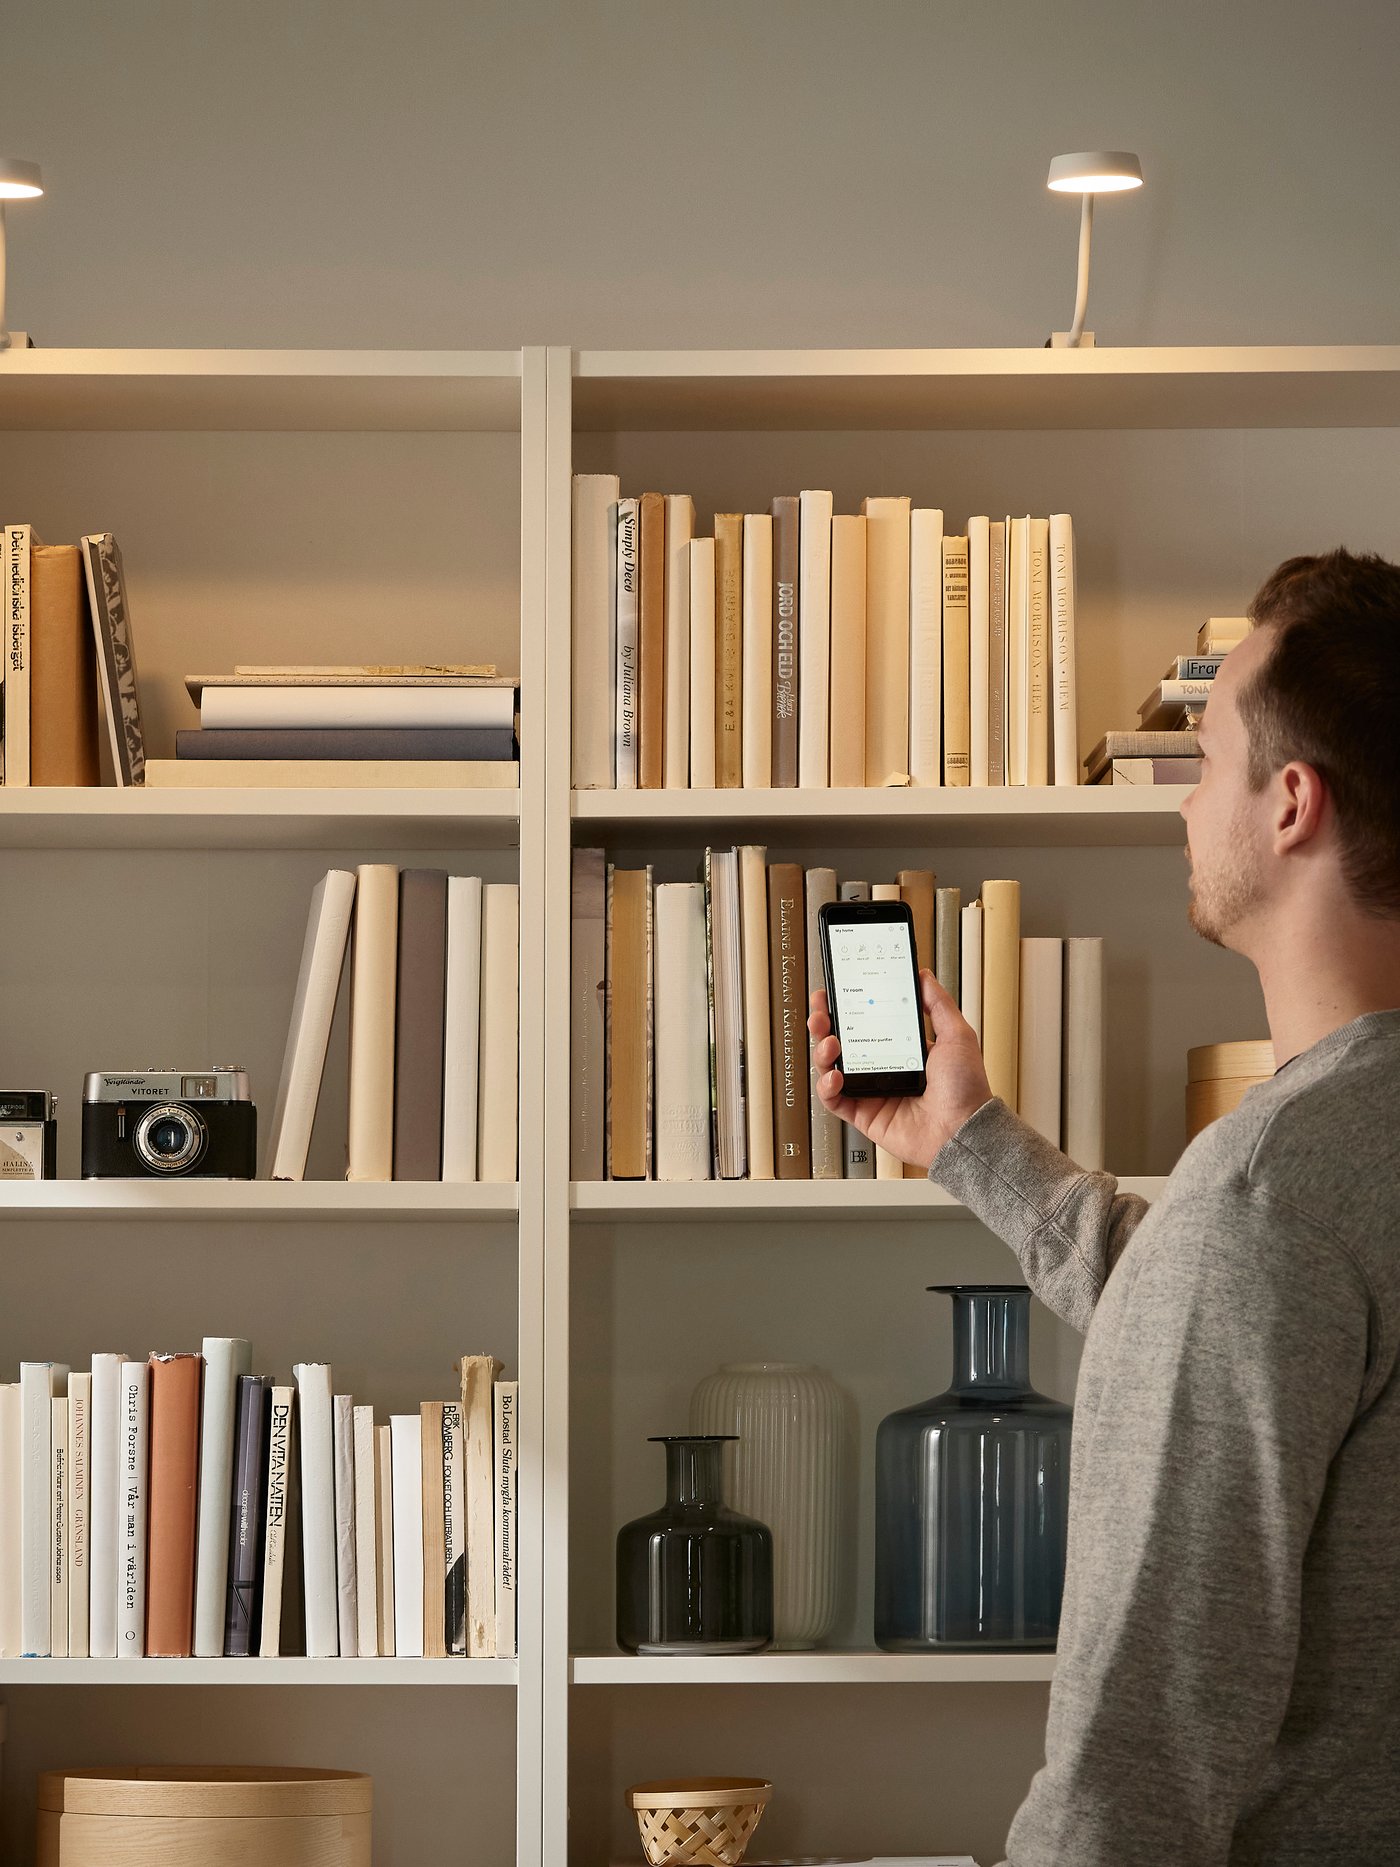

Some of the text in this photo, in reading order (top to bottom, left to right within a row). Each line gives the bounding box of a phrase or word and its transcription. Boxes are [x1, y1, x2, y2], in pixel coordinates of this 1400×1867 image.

[12, 553, 24, 620] medicinska
[622, 518, 636, 593] Simply Deco
[11, 623, 25, 672] isberget
[776, 581, 794, 679] JORD OCH ELD
[1032, 548, 1043, 715] TONI MORRISON HEM
[1055, 544, 1069, 711] TONI MORRISON HEM
[622, 645, 635, 748] by Juliana Brown
[779, 898, 798, 1108] ELAINE KAGAN KÄRLEKSBAND
[273, 1405, 290, 1438] DEN
[452, 1413, 460, 1430] ERIK
[502, 1395, 512, 1410] Bo
[502, 1410, 512, 1445] Lostad
[74, 1398, 86, 1567] JOHANNES SALMINEN GRÄNSLAND
[272, 1439, 286, 1469] VITA
[443, 1405, 456, 1564] BLOMBERG FOLKET OCH LITTERATUREN
[502, 1448, 512, 1474] Sluta
[125, 1384, 139, 1610] Chris Forsne Vår man i världen
[240, 1516, 249, 1531] with
[269, 1472, 285, 1527] NATTEN
[501, 1508, 513, 1591] kommunalrådet!
